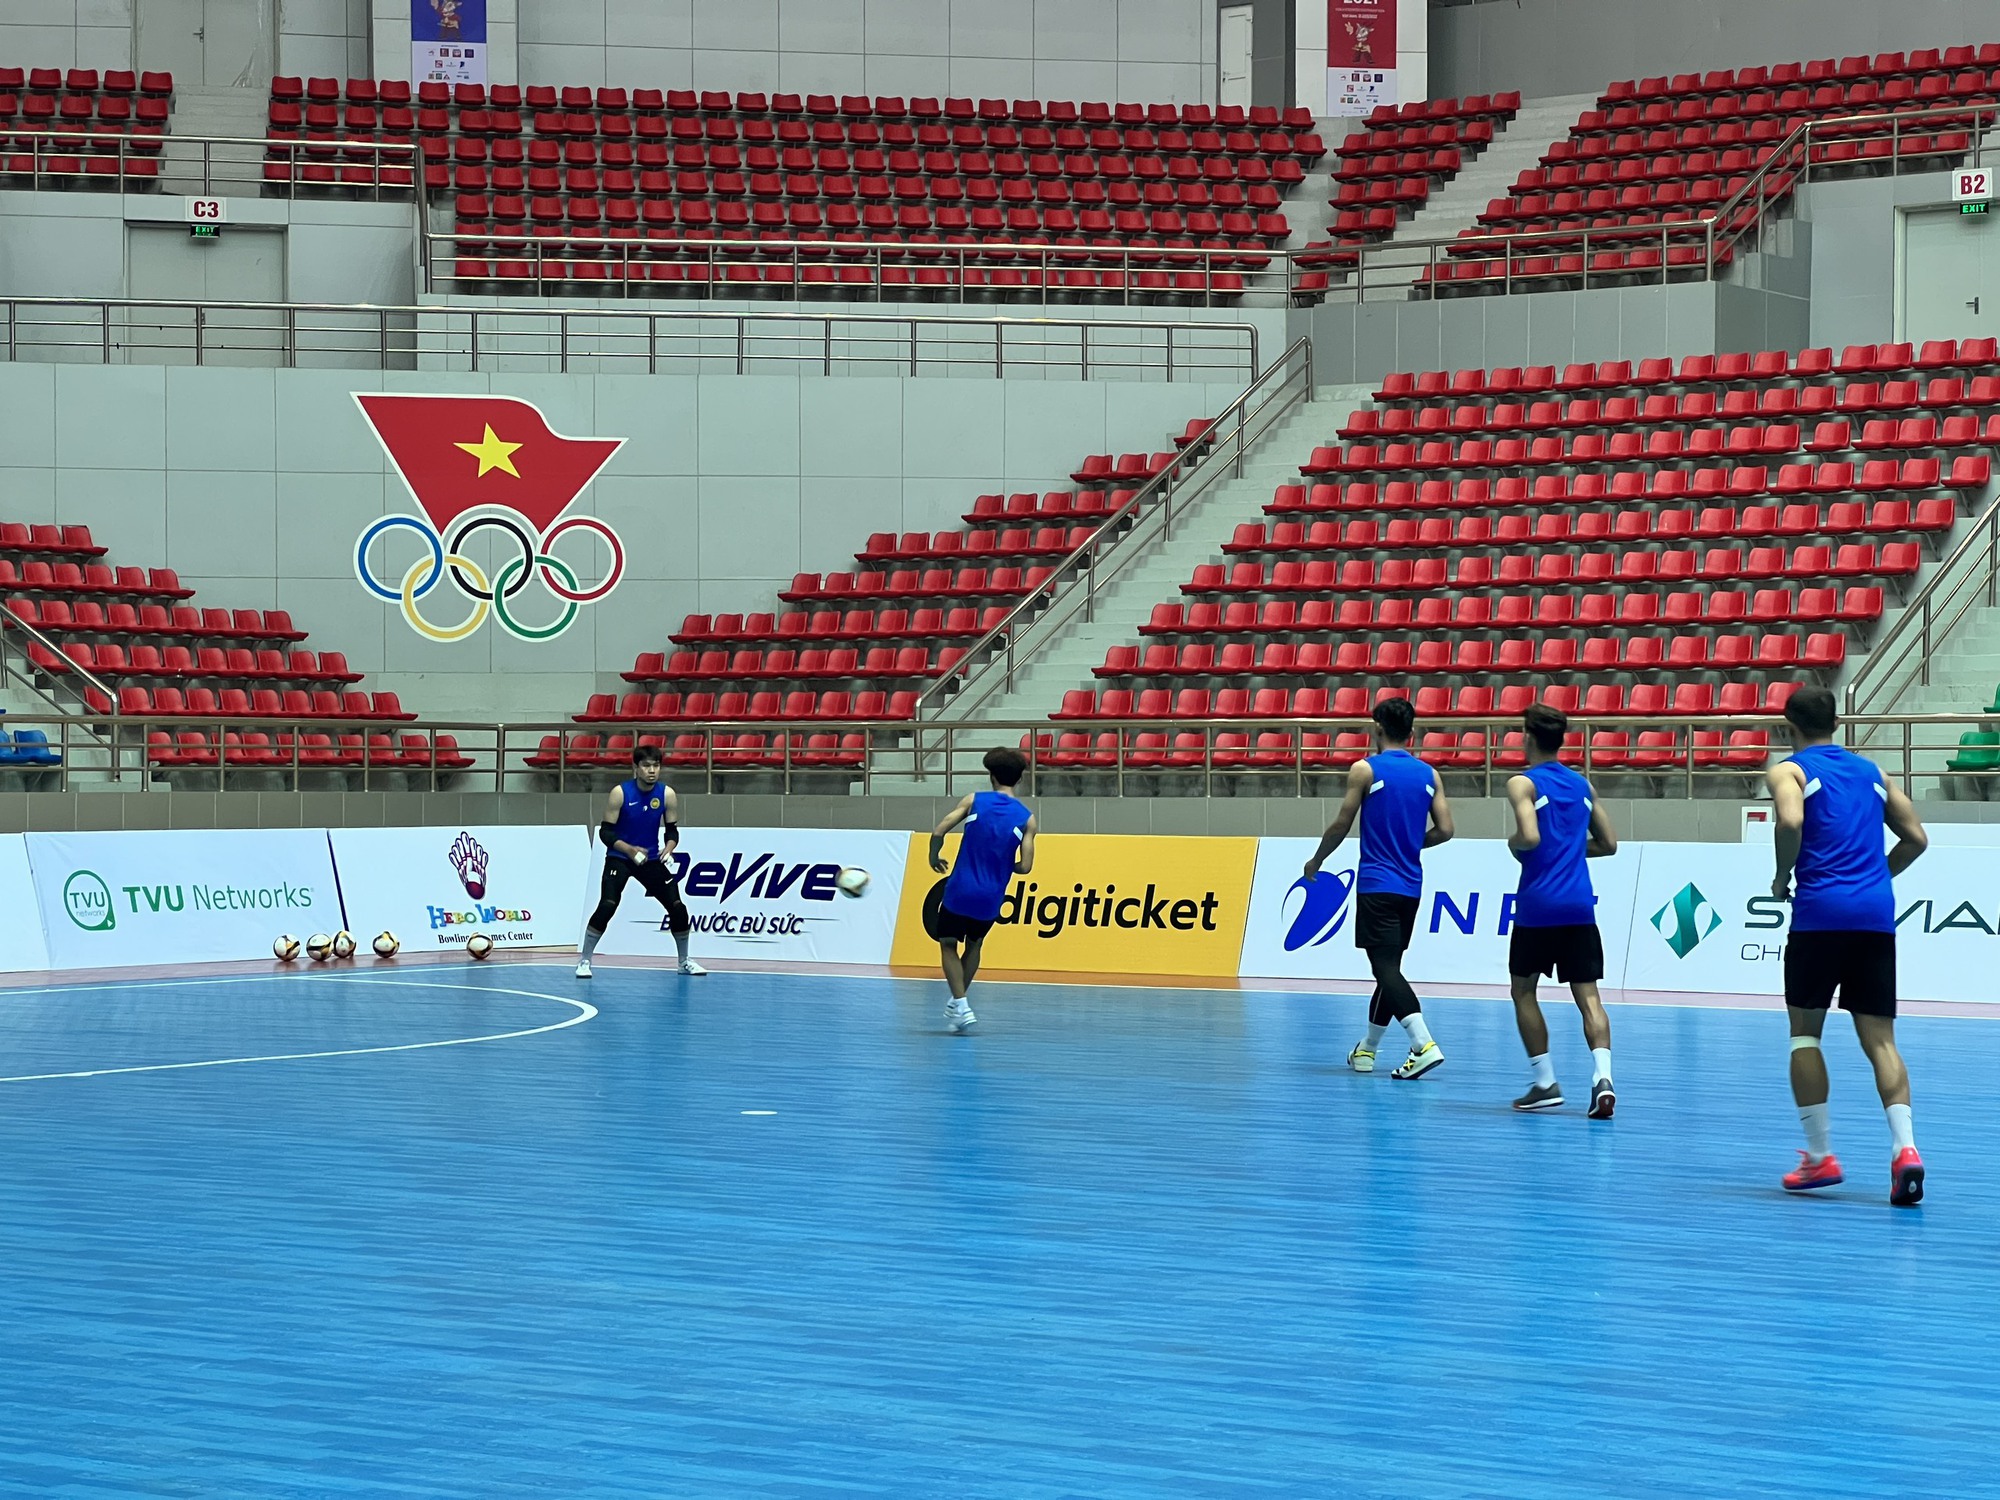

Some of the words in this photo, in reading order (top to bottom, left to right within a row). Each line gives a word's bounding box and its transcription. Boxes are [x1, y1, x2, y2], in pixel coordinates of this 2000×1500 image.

[1961, 174, 1985, 195] B2
[194, 201, 219, 218] C3
[1962, 204, 1986, 213] EXIT
[69, 891, 106, 909] TVU
[122, 885, 184, 913] TVU
[192, 881, 312, 911] Networks
[426, 905, 477, 929] HERO
[475, 904, 531, 924] WORLD
[996, 881, 1219, 938] digiticket
[739, 912, 767, 934] BÙ
[767, 912, 805, 935] SỨC
[507, 931, 533, 941] Center
